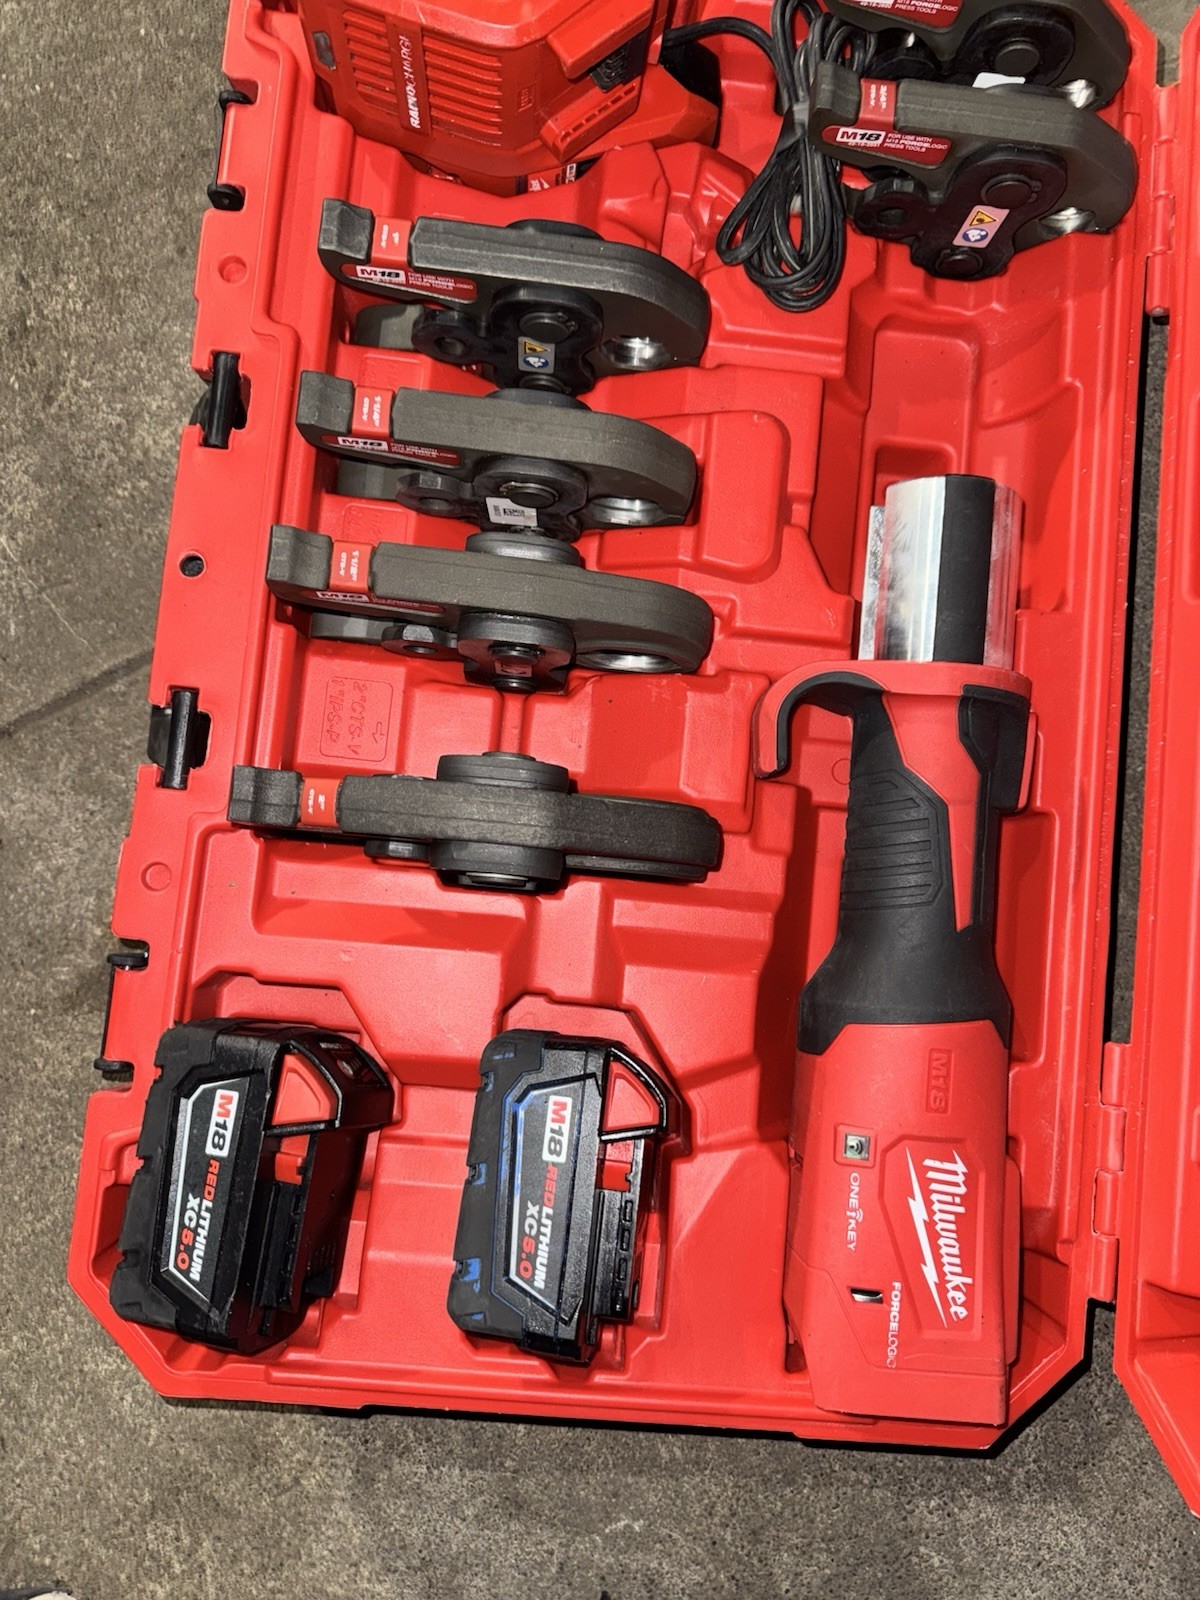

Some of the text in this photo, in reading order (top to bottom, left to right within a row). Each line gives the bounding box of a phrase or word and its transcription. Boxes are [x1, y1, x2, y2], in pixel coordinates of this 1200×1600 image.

[895, 3, 937, 14] PRESS TOOLS
[839, 131, 882, 141] M18
[360, 269, 400, 278] M18
[341, 438, 383, 447] M18
[930, 1052, 950, 1111] M18
[211, 1093, 234, 1151] M18
[547, 1100, 568, 1158] M18
[177, 1193, 200, 1270] XC5.0
[190, 1157, 220, 1282] REDLITHIUM
[519, 1200, 539, 1279] XC5.0
[534, 1163, 558, 1290] REDLITHIUM
[922, 1149, 973, 1322] Milwaukee
[887, 1281, 902, 1369] FORCELOGIC
